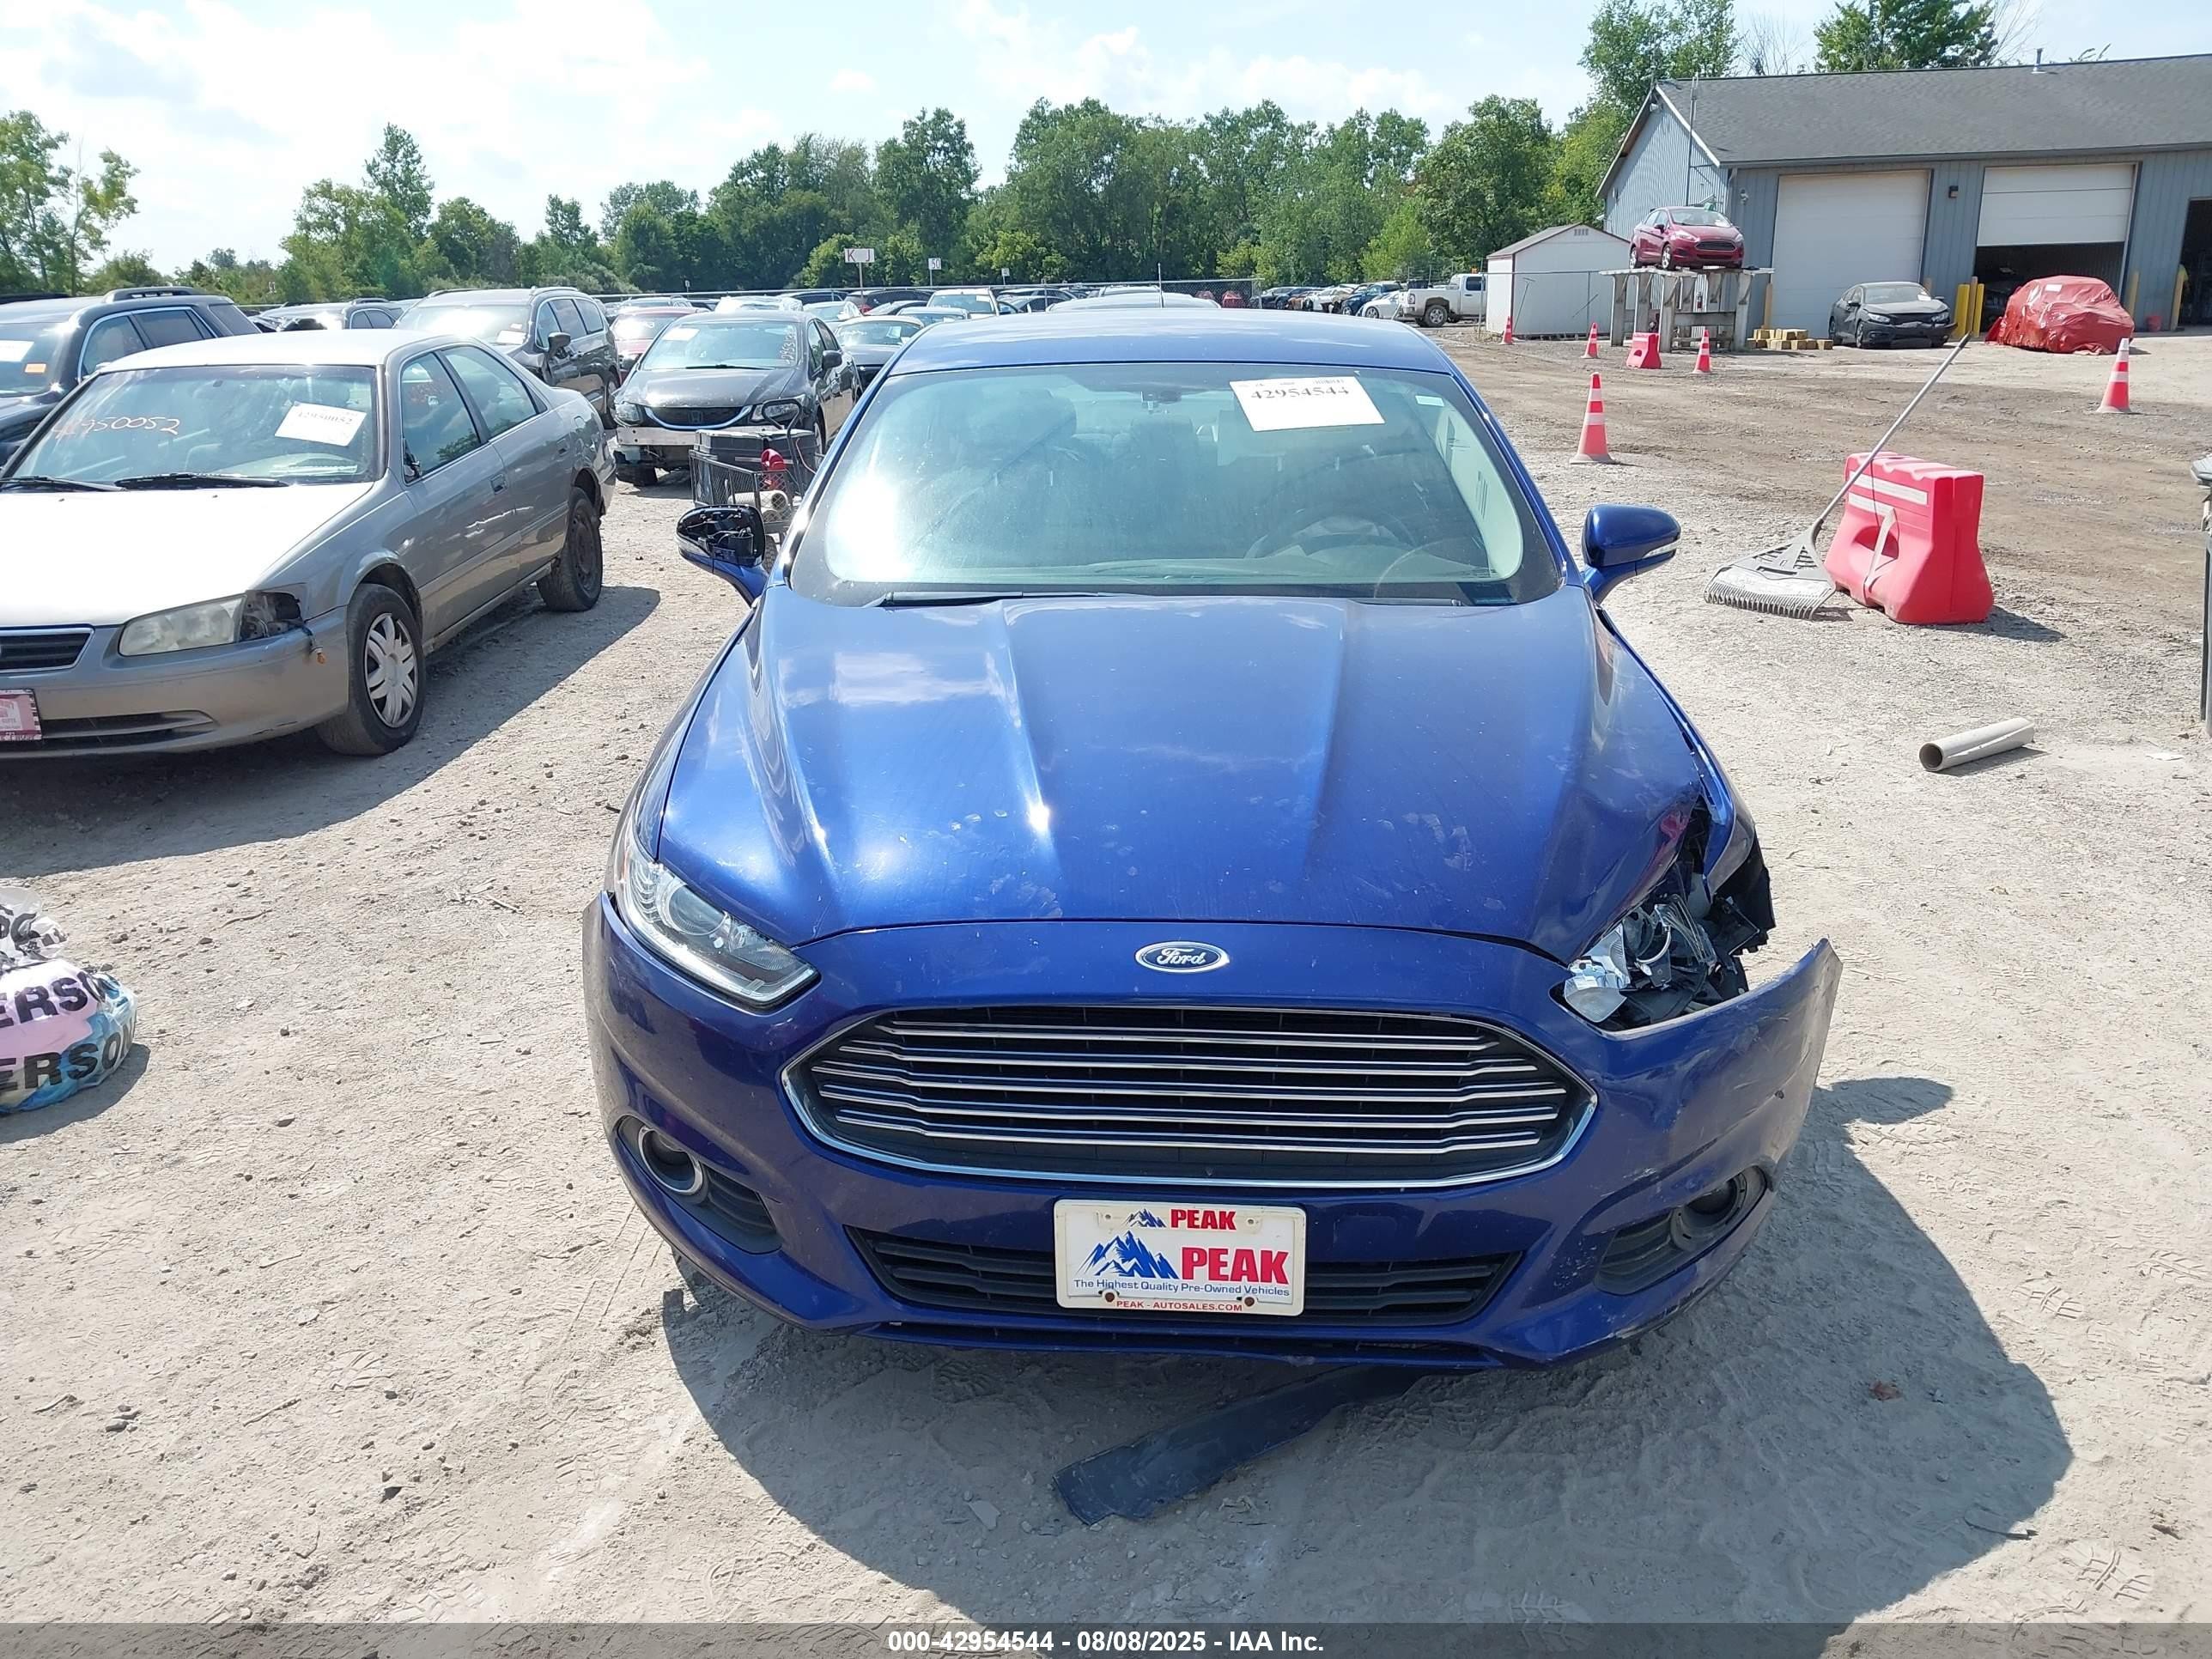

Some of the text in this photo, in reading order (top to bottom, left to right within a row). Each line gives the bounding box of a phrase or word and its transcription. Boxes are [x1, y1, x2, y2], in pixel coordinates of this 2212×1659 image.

[847, 249, 871, 262] K J
[931, 258, 941, 269] 50
[1157, 947, 1206, 964] Ford
[1170, 1208, 1237, 1231] PEAK
[1181, 1246, 1290, 1285] PEAK
[1073, 1279, 1290, 1297] The Highest Quality Pre-Owned Vehicles
[1153, 1302, 1243, 1312] AUTOSALES.COM
